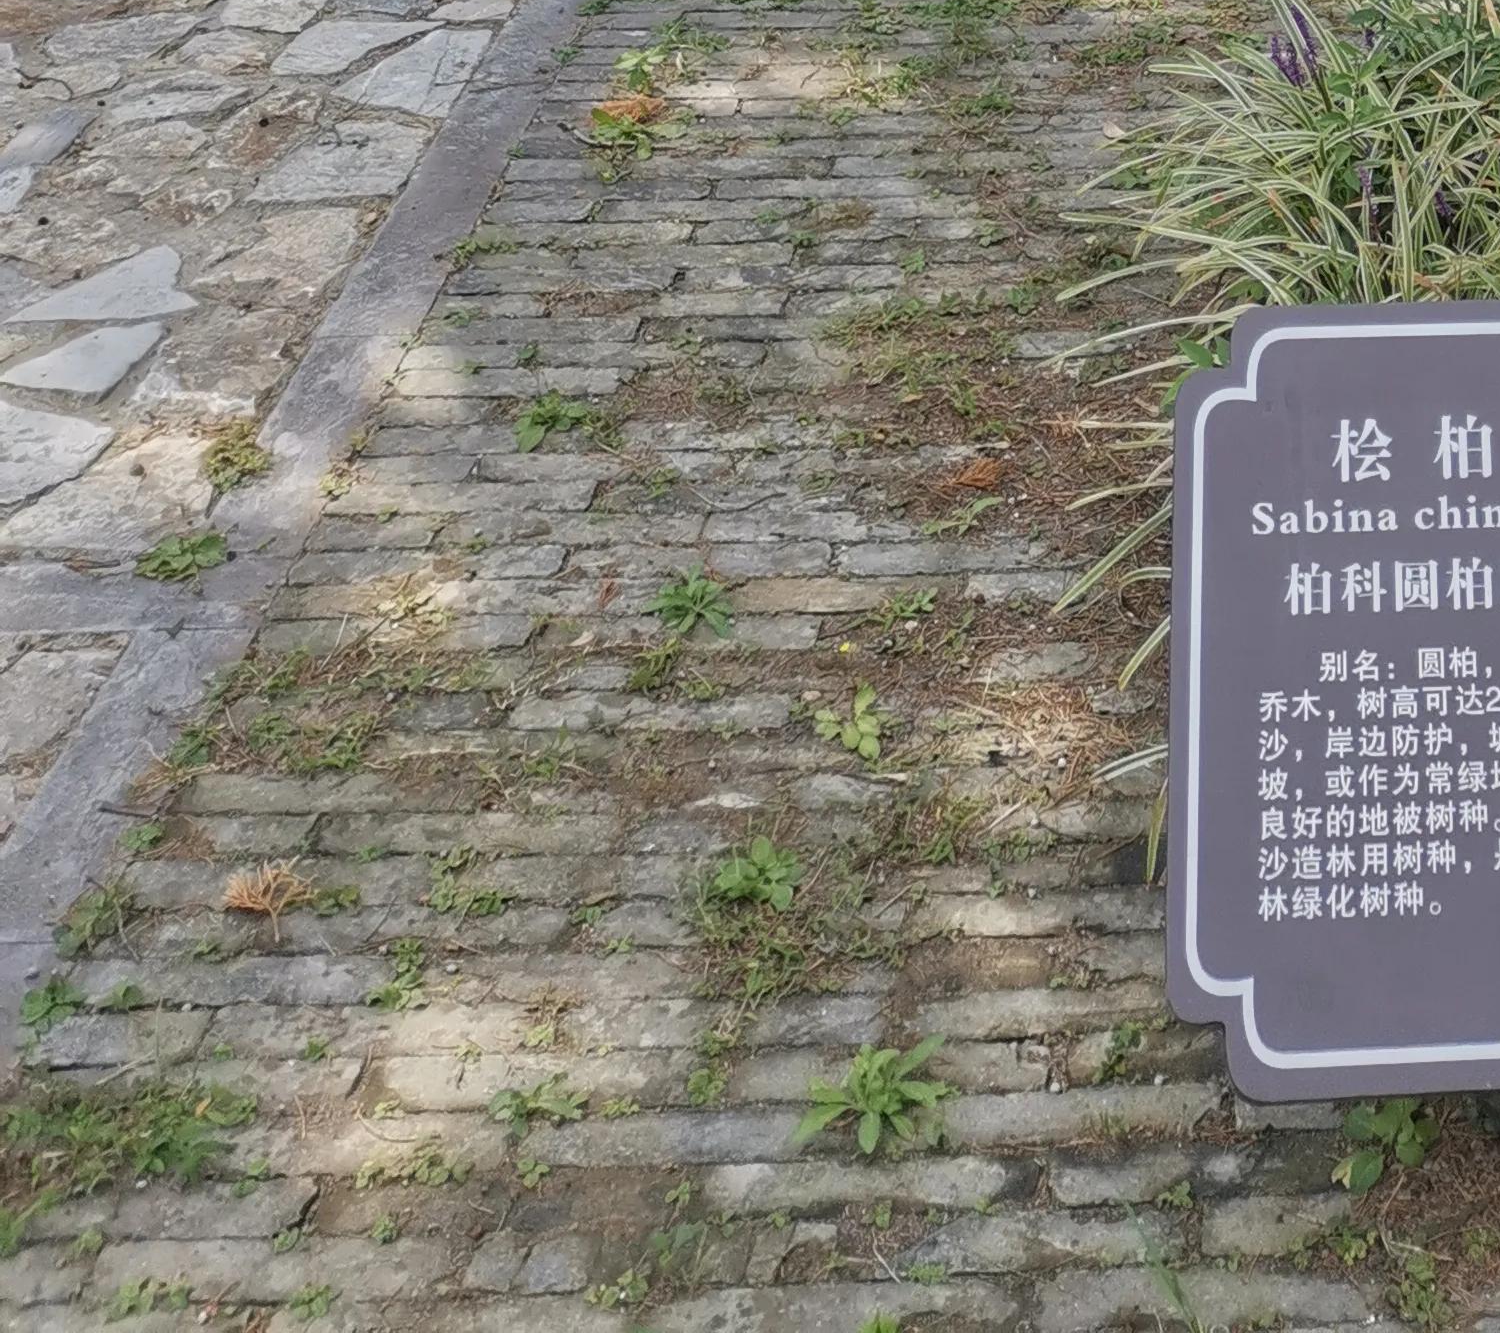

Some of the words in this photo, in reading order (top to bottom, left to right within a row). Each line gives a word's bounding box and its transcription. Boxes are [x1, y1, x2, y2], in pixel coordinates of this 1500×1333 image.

[1251, 498, 1399, 535] Sabina
[1258, 881, 1442, 922] 林绿化树种。
